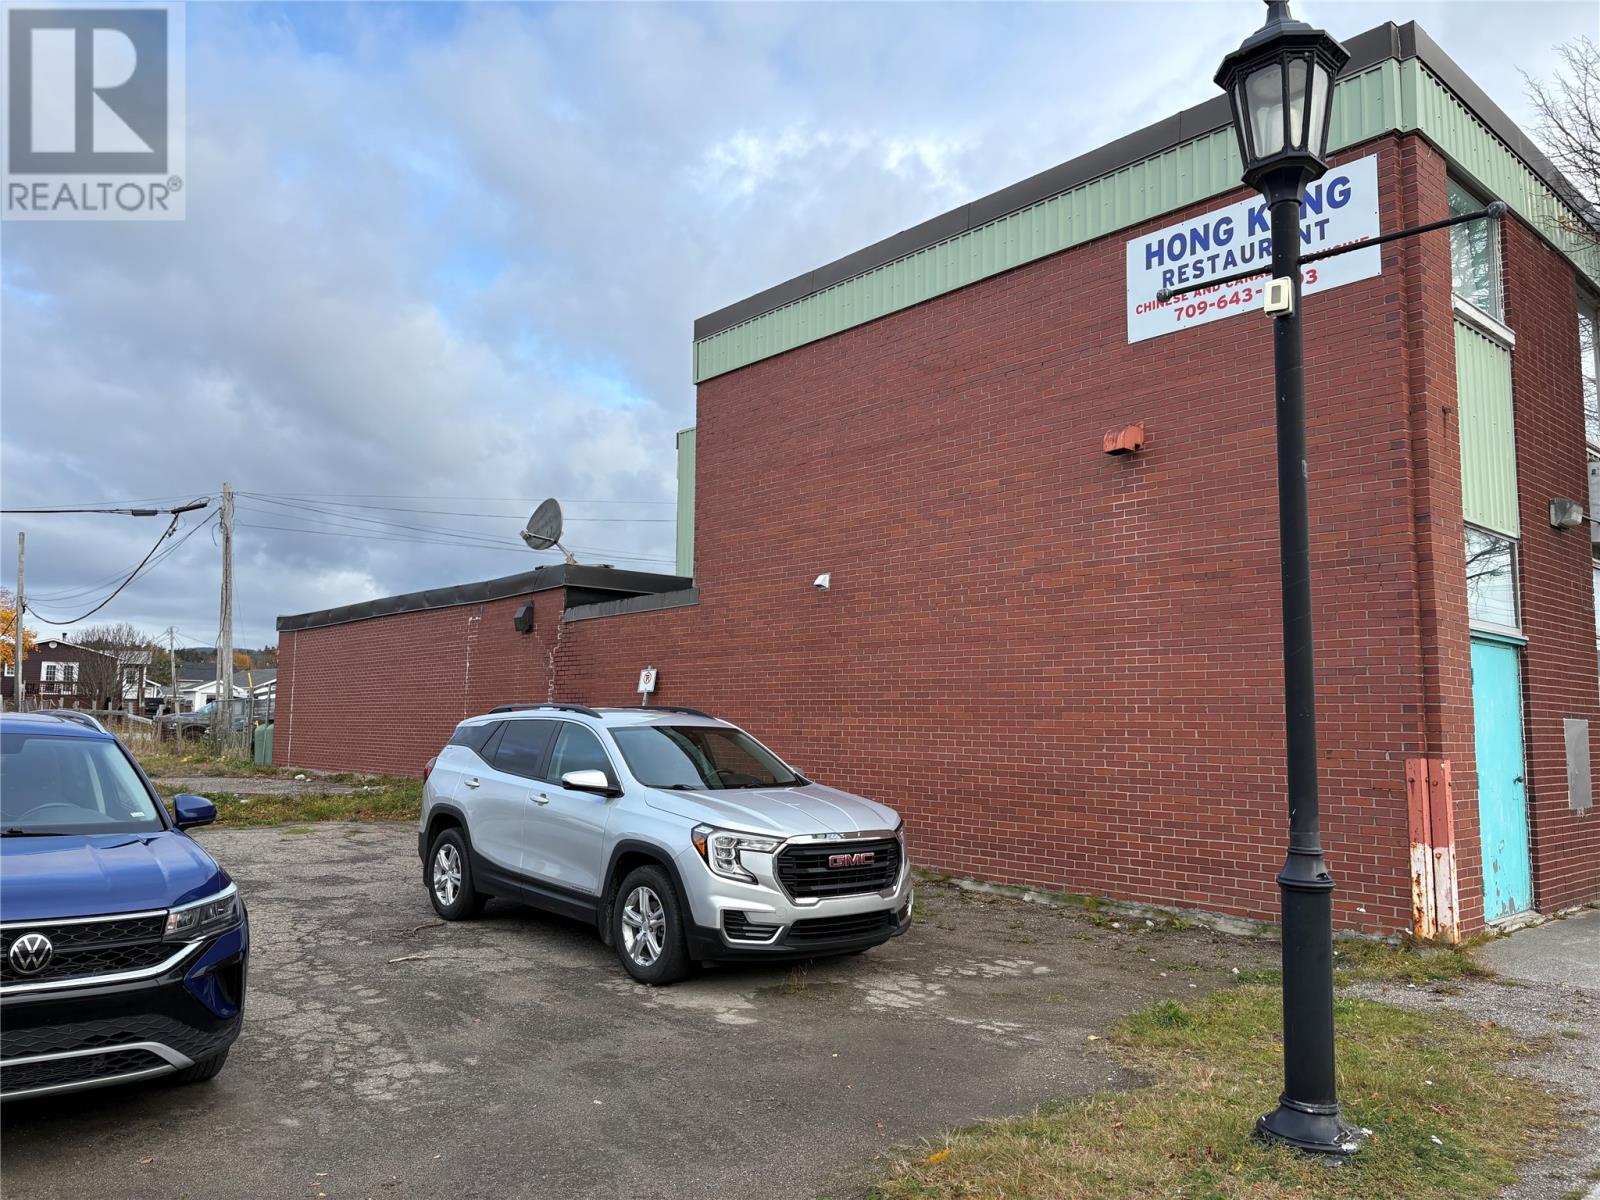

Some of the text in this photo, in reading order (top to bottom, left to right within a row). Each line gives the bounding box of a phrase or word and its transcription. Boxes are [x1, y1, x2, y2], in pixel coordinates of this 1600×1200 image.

[1145, 216, 1235, 271] HONG
[1247, 175, 1352, 238] KNG
[1162, 218, 1330, 289] RESTAURNT
[1193, 284, 1221, 298] AND
[828, 852, 875, 868] GMC
